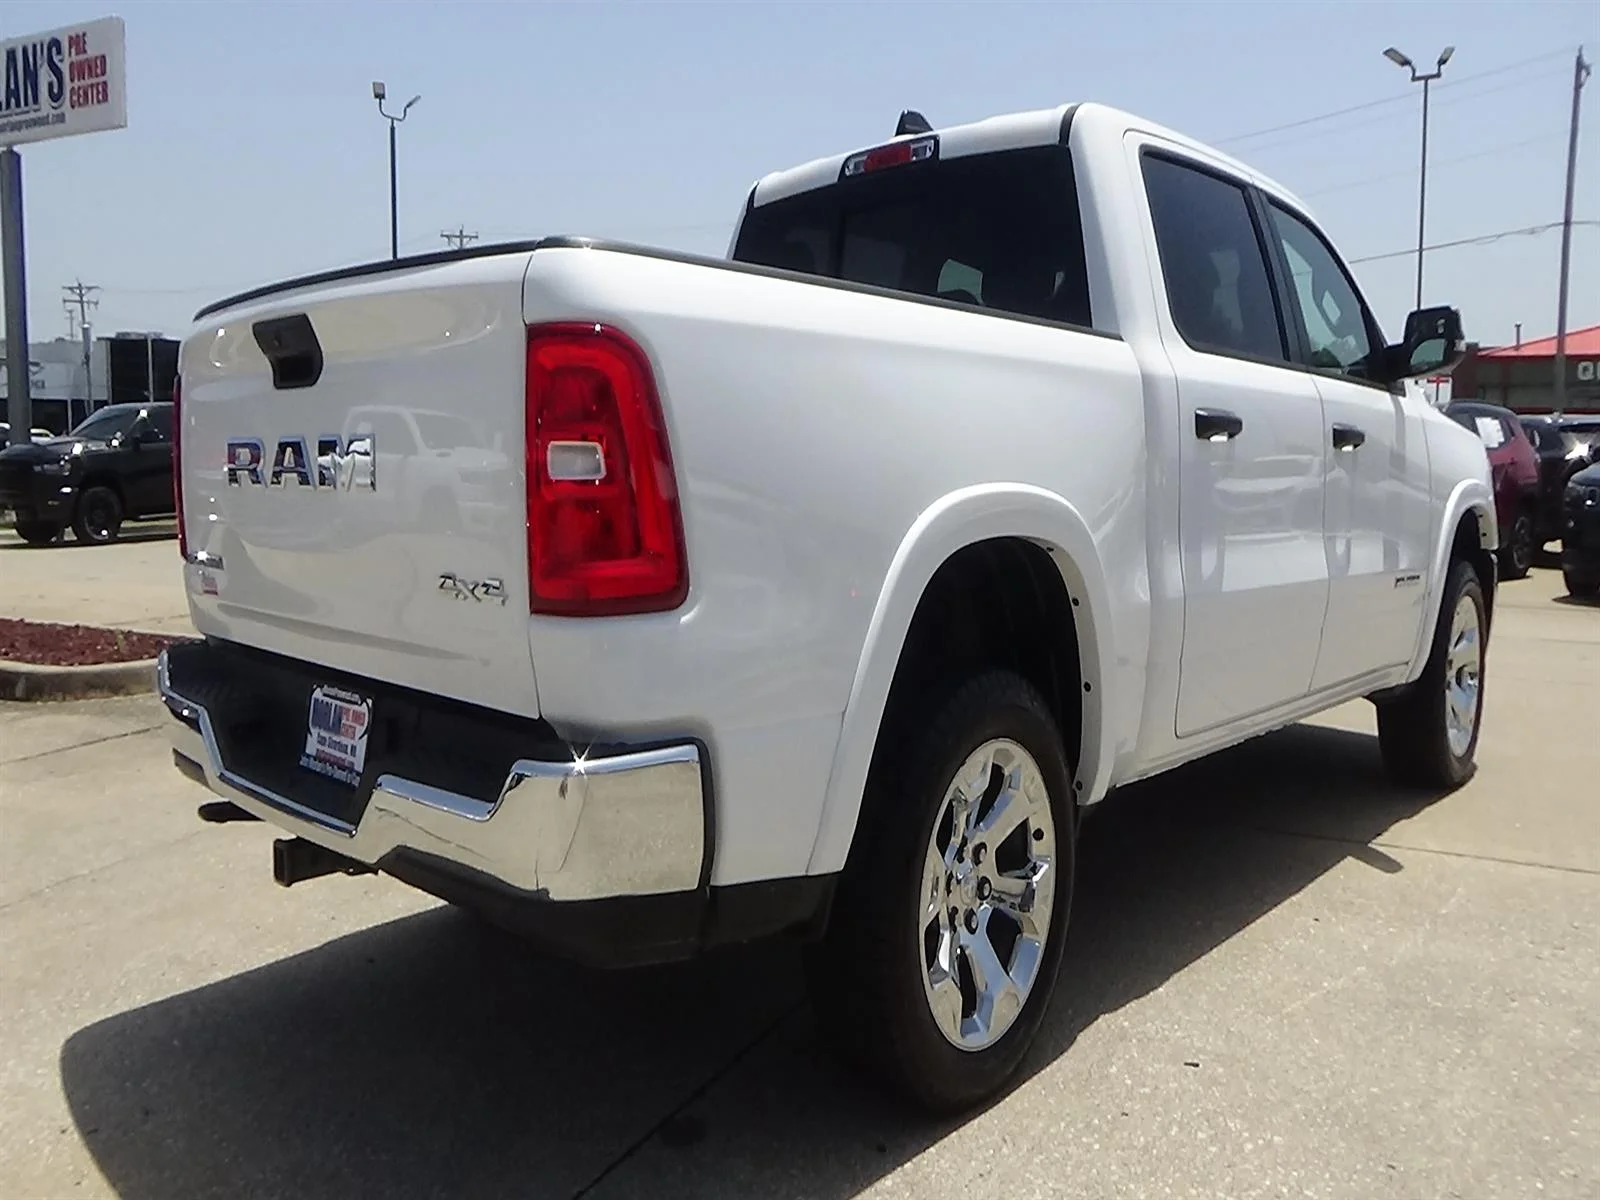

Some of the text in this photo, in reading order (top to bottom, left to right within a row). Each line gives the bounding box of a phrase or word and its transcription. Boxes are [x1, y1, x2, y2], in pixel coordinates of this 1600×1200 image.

[68, 32, 87, 57] PRE
[0, 37, 64, 111] AN'S
[69, 54, 107, 83] OWNED
[69, 81, 109, 109] CENTER
[226, 435, 376, 492] RAM
